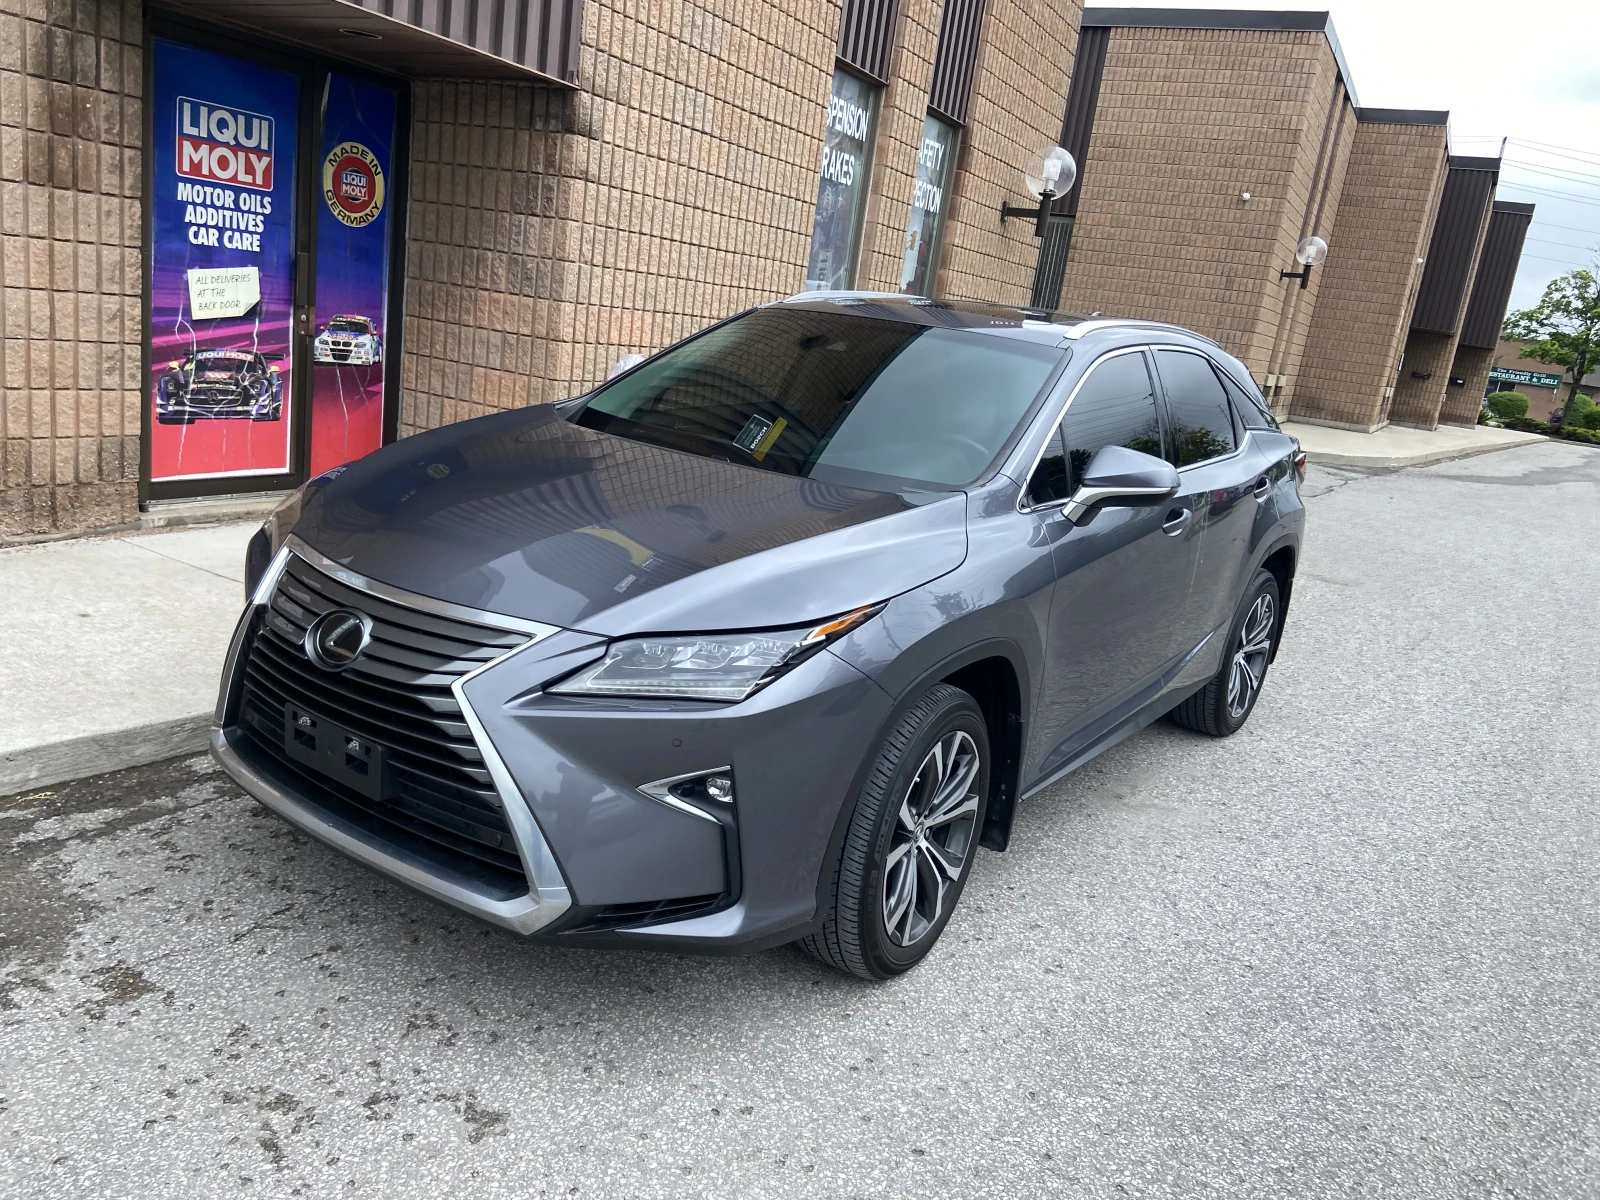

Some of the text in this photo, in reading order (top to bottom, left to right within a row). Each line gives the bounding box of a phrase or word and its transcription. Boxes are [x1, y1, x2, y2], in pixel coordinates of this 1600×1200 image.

[183, 102, 269, 150] LIQUI
[182, 140, 271, 185] MOLY
[328, 145, 381, 176] MADE IN
[821, 145, 854, 186] RAKES
[342, 173, 366, 187] LIQUI
[342, 185, 367, 197] MOLY
[177, 182, 272, 214] MOTOR OILS
[325, 189, 380, 226] GERMANY
[184, 205, 264, 232] ADDITIVES
[188, 225, 261, 252] CAR CARE
[196, 274, 251, 285] ALL DELIVERIES
[197, 288, 226, 298] AT THE
[198, 300, 241, 311] BACK DOOR
[750, 427, 767, 449] BOSCH
